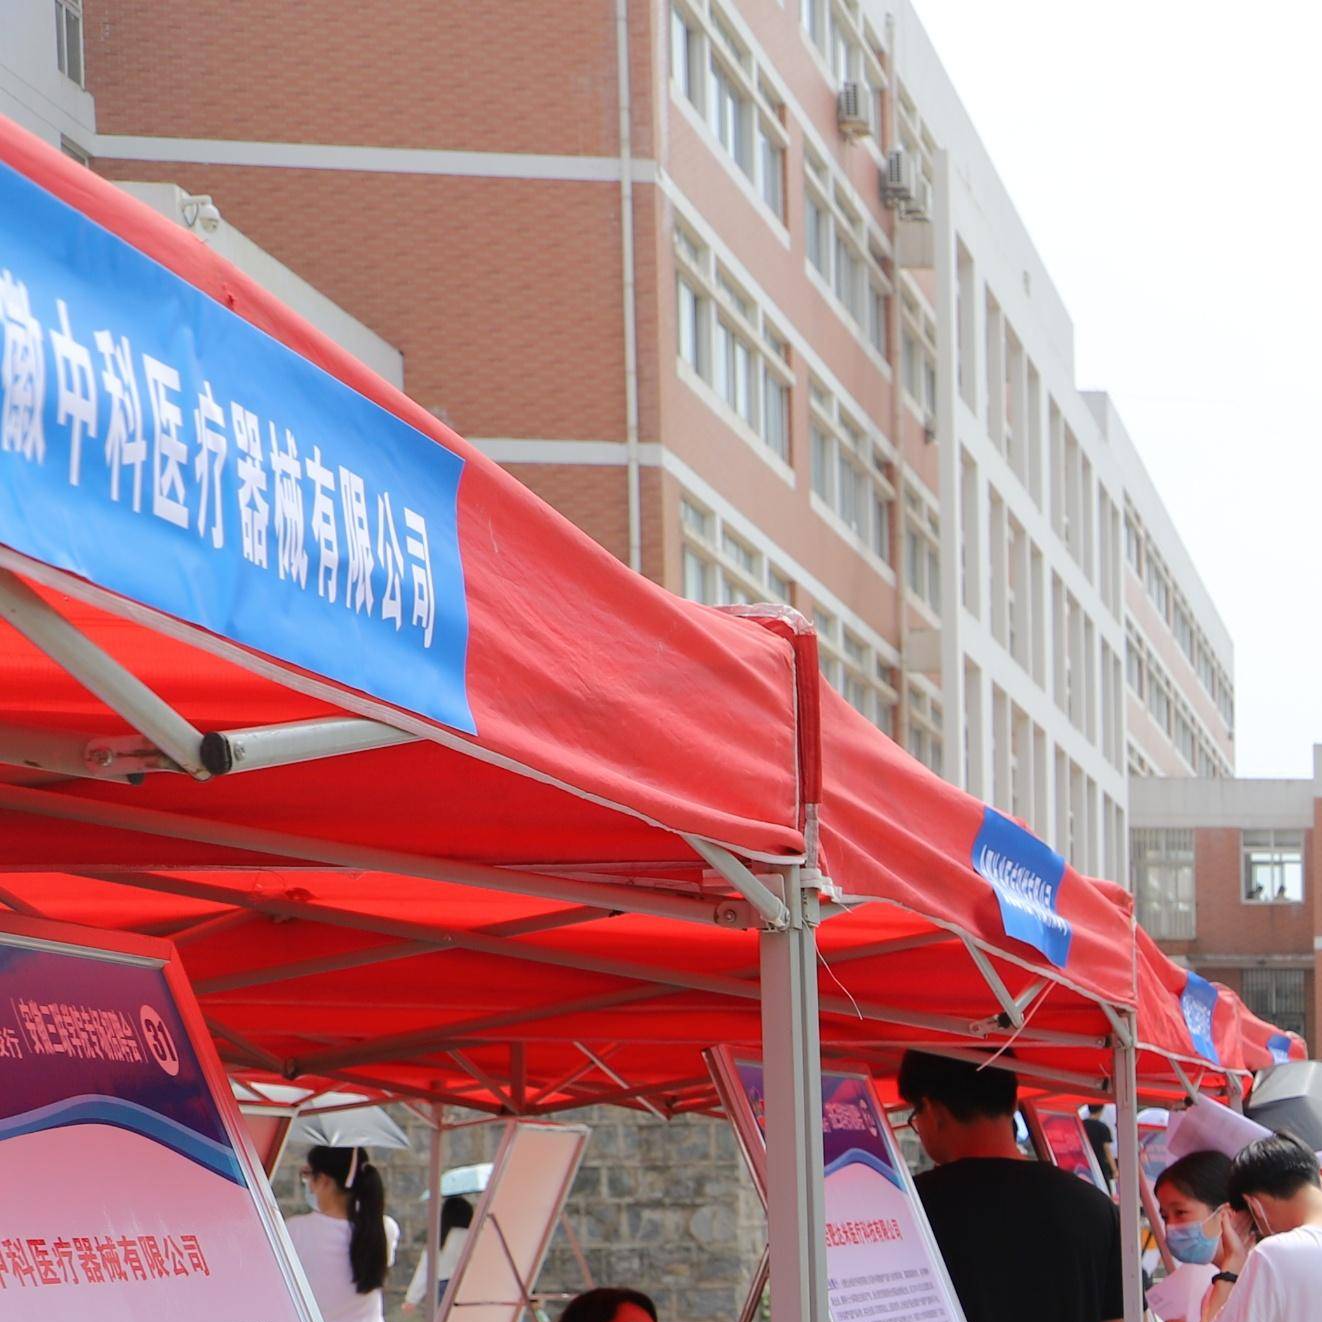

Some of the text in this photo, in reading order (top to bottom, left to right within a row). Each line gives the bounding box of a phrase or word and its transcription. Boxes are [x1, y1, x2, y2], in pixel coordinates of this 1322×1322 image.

[0, 268, 435, 649] 徽中科医疗器械有限公司
[144, 1018, 178, 1062] 31
